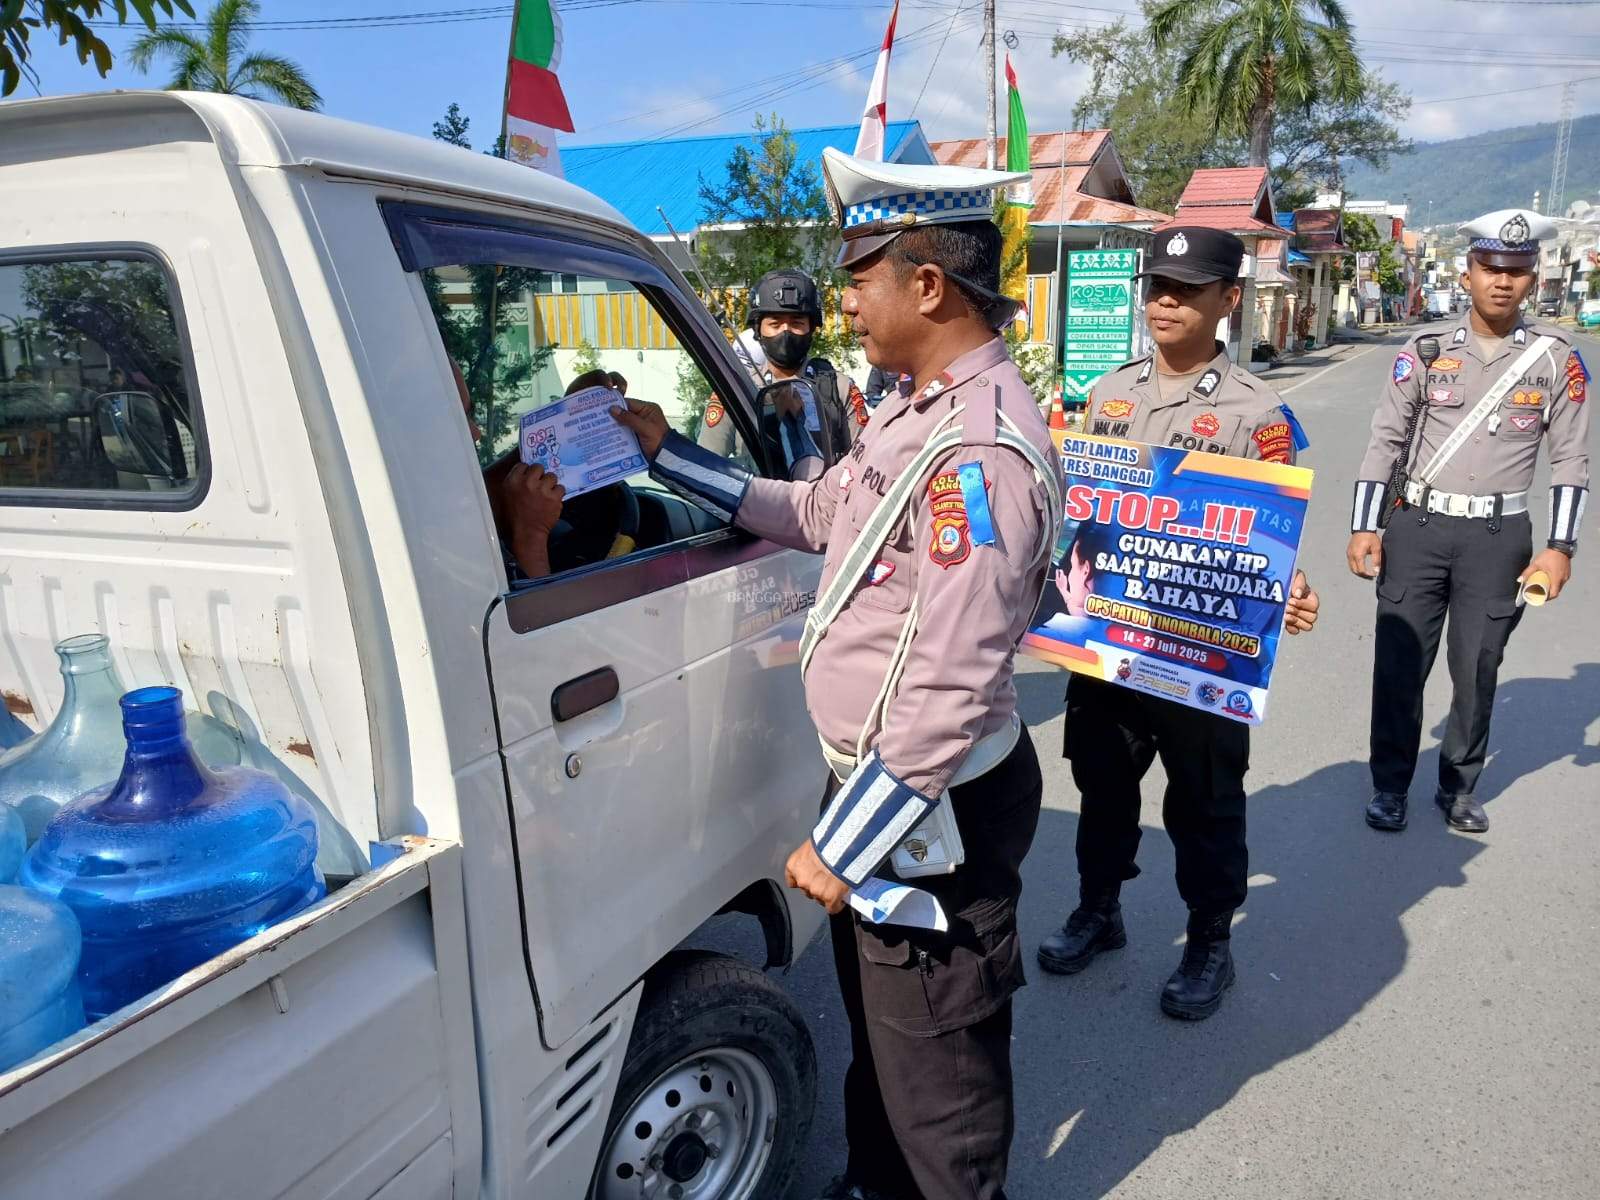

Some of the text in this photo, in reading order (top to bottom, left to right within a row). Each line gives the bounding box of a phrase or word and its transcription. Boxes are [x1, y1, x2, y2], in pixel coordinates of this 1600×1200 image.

[1072, 285, 1126, 298] KOSTA
[1428, 374, 1459, 384] RAY
[1518, 376, 1549, 387] OLRI
[1063, 438, 1138, 463] SAT LANTAS
[861, 465, 896, 497] POL
[935, 482, 961, 492] BANG
[1093, 463, 1152, 486] BANGGAI
[1118, 534, 1269, 575] GUNAKAN HP
[1095, 552, 1284, 602] SAAT BERKENDARA
[1124, 579, 1239, 620] BAHAYA
[1086, 597, 1259, 654] OPS PATUH TINOMBALA 2025
[1122, 630, 1134, 643] 14
[1142, 635, 1155, 648] 27
[1157, 639, 1175, 654] Juli
[1180, 645, 1207, 663] 2025
